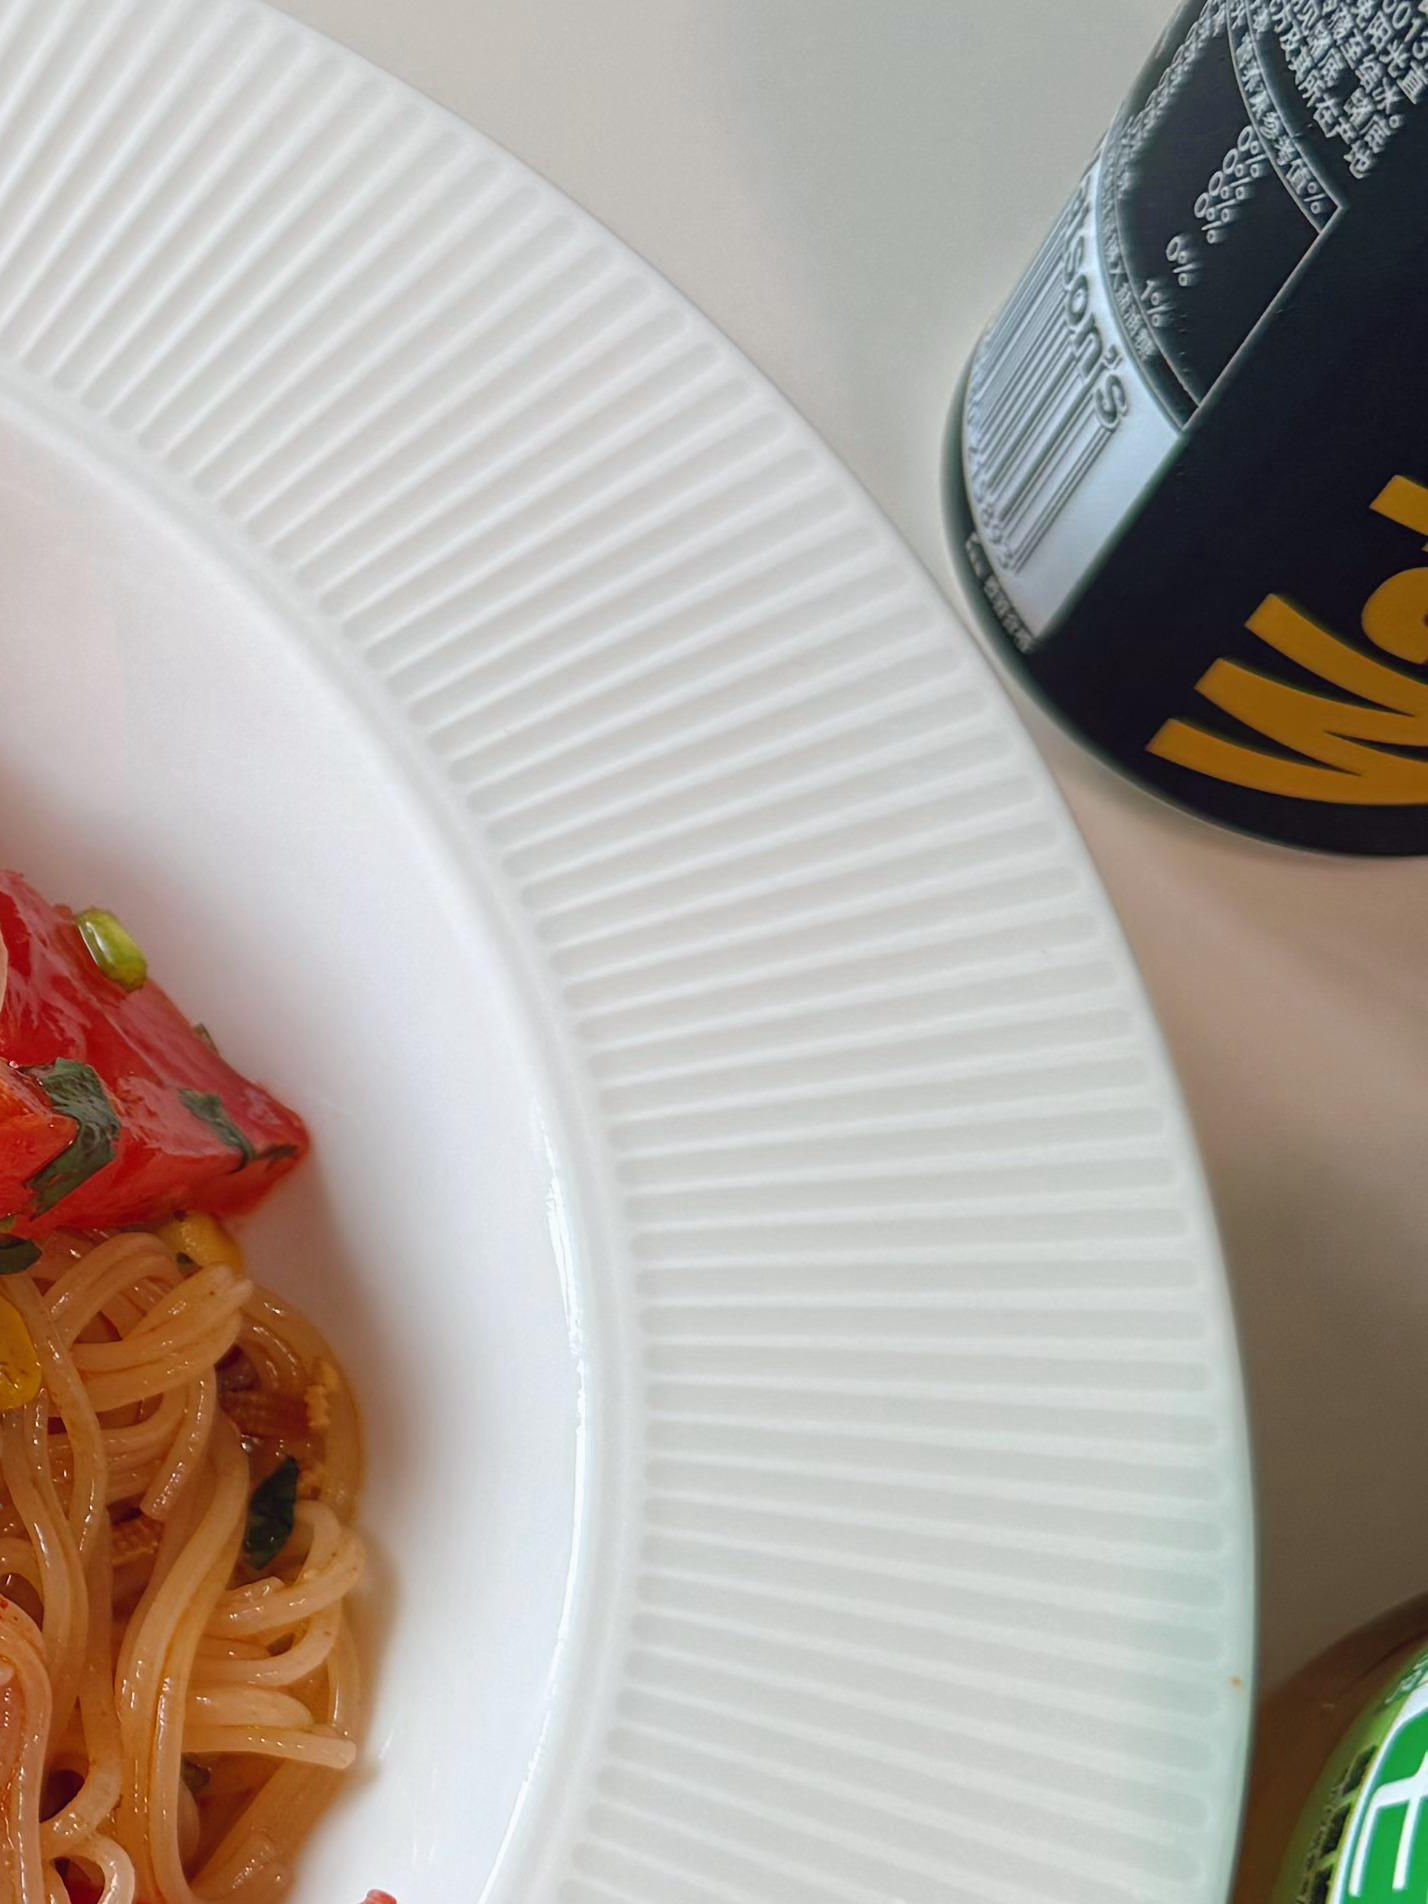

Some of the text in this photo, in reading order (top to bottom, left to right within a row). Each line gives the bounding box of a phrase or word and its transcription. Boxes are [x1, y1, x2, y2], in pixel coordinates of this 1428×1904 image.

[1223, 148, 1252, 201] 0%
[1238, 124, 1266, 177] 0%
[1194, 192, 1222, 245] 0%
[1208, 170, 1237, 224] 0%
[1166, 234, 1194, 287] 0%
[1141, 280, 1166, 328] 1%
